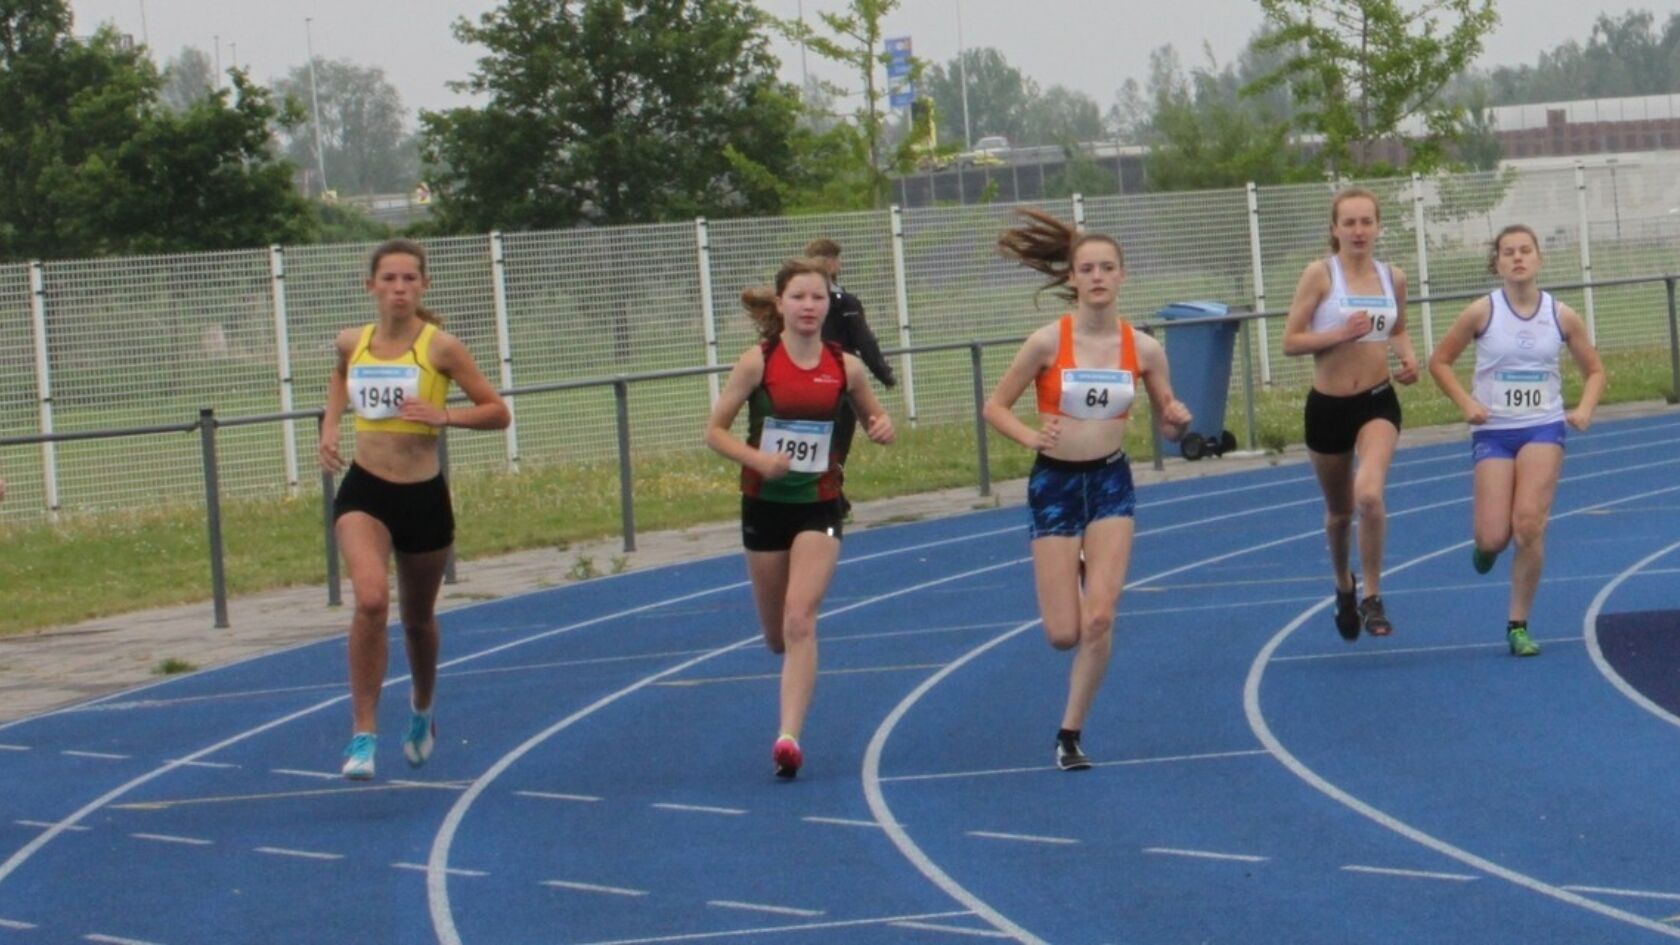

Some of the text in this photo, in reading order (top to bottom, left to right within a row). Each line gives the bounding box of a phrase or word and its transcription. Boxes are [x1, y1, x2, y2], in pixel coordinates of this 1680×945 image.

[359, 386, 405, 409] 1948
[1085, 388, 1109, 408] 64
[1504, 388, 1542, 408] 1910
[775, 437, 818, 463] 1891
